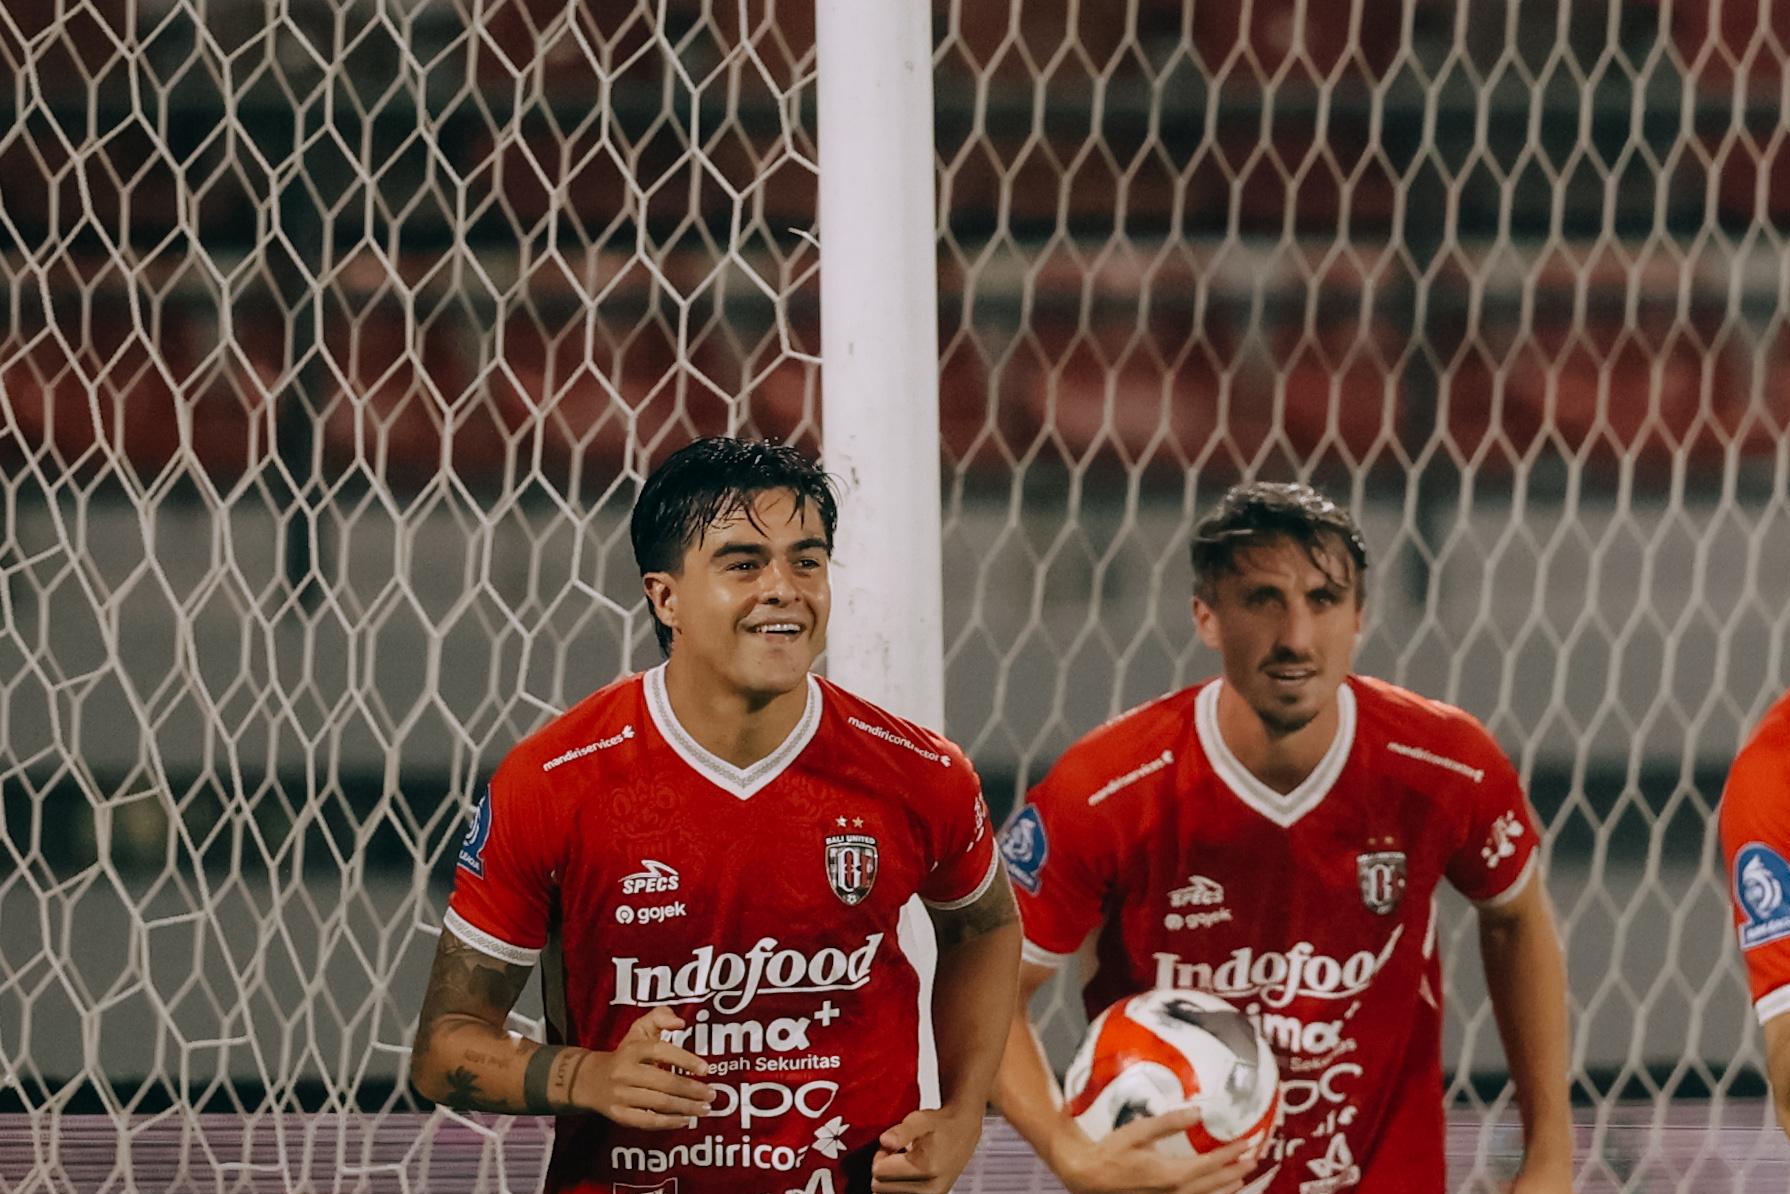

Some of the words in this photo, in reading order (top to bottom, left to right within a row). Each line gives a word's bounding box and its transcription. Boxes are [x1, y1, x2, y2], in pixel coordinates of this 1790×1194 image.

[622, 876, 680, 895] SPECS
[637, 901, 687, 925] gojek
[610, 933, 884, 1015] Indofood
[754, 1053, 841, 1073] Sekuritas
[688, 1080, 840, 1129] ppo
